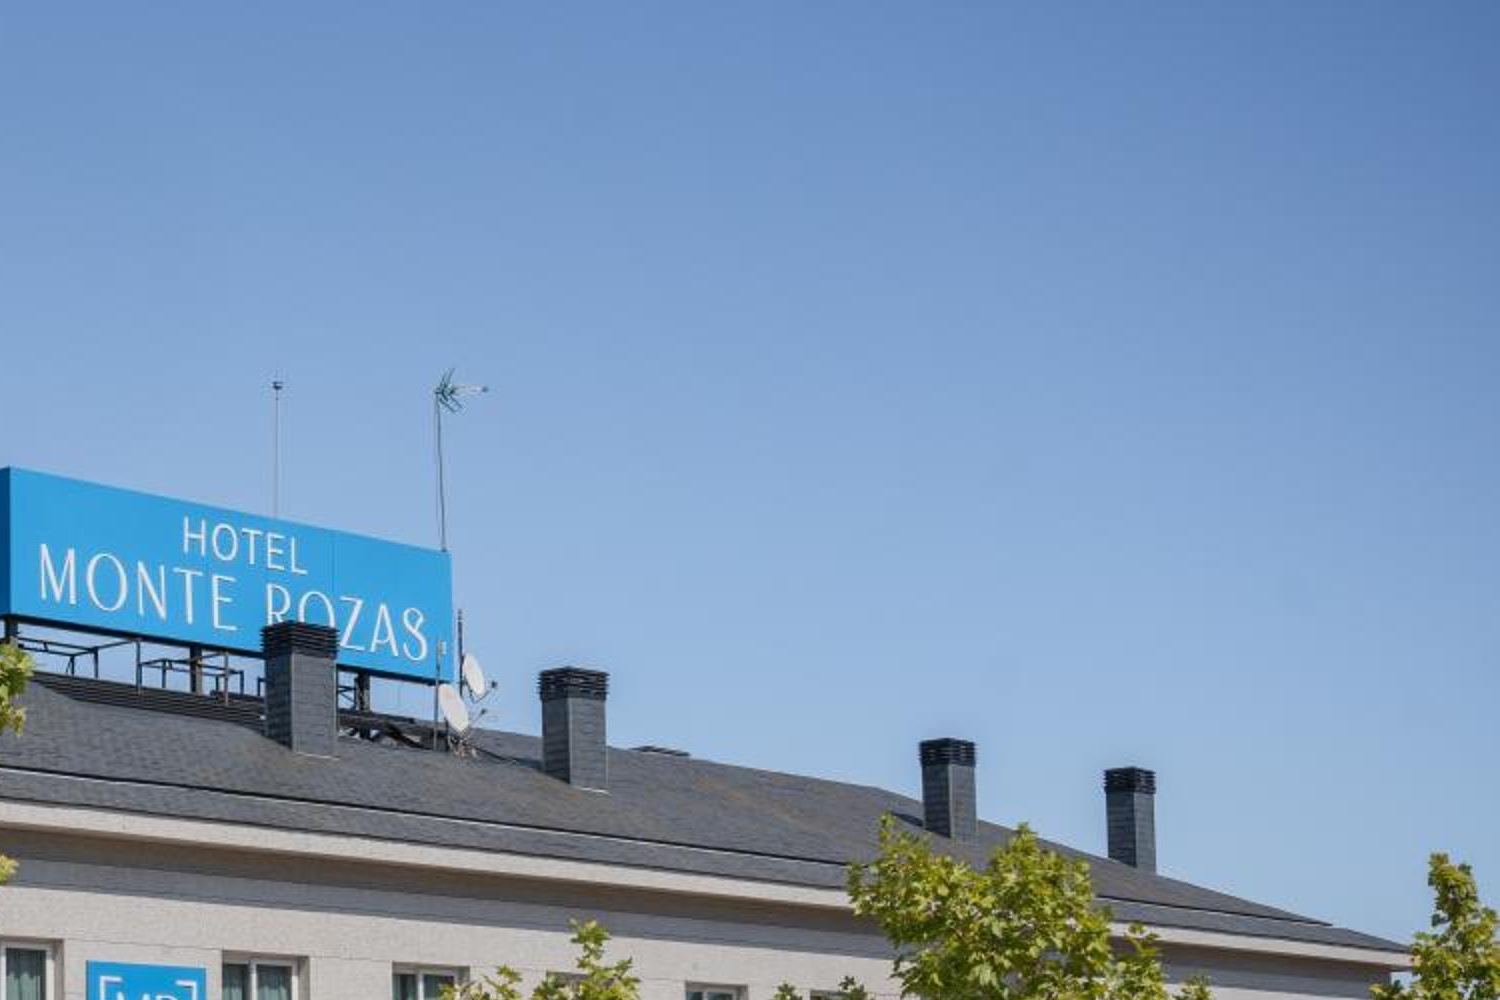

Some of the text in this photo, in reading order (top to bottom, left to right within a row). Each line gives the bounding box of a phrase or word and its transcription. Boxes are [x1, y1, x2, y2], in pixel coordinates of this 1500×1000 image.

[182, 515, 308, 575] HOTEL
[39, 542, 428, 661] MONTE ROZAS
